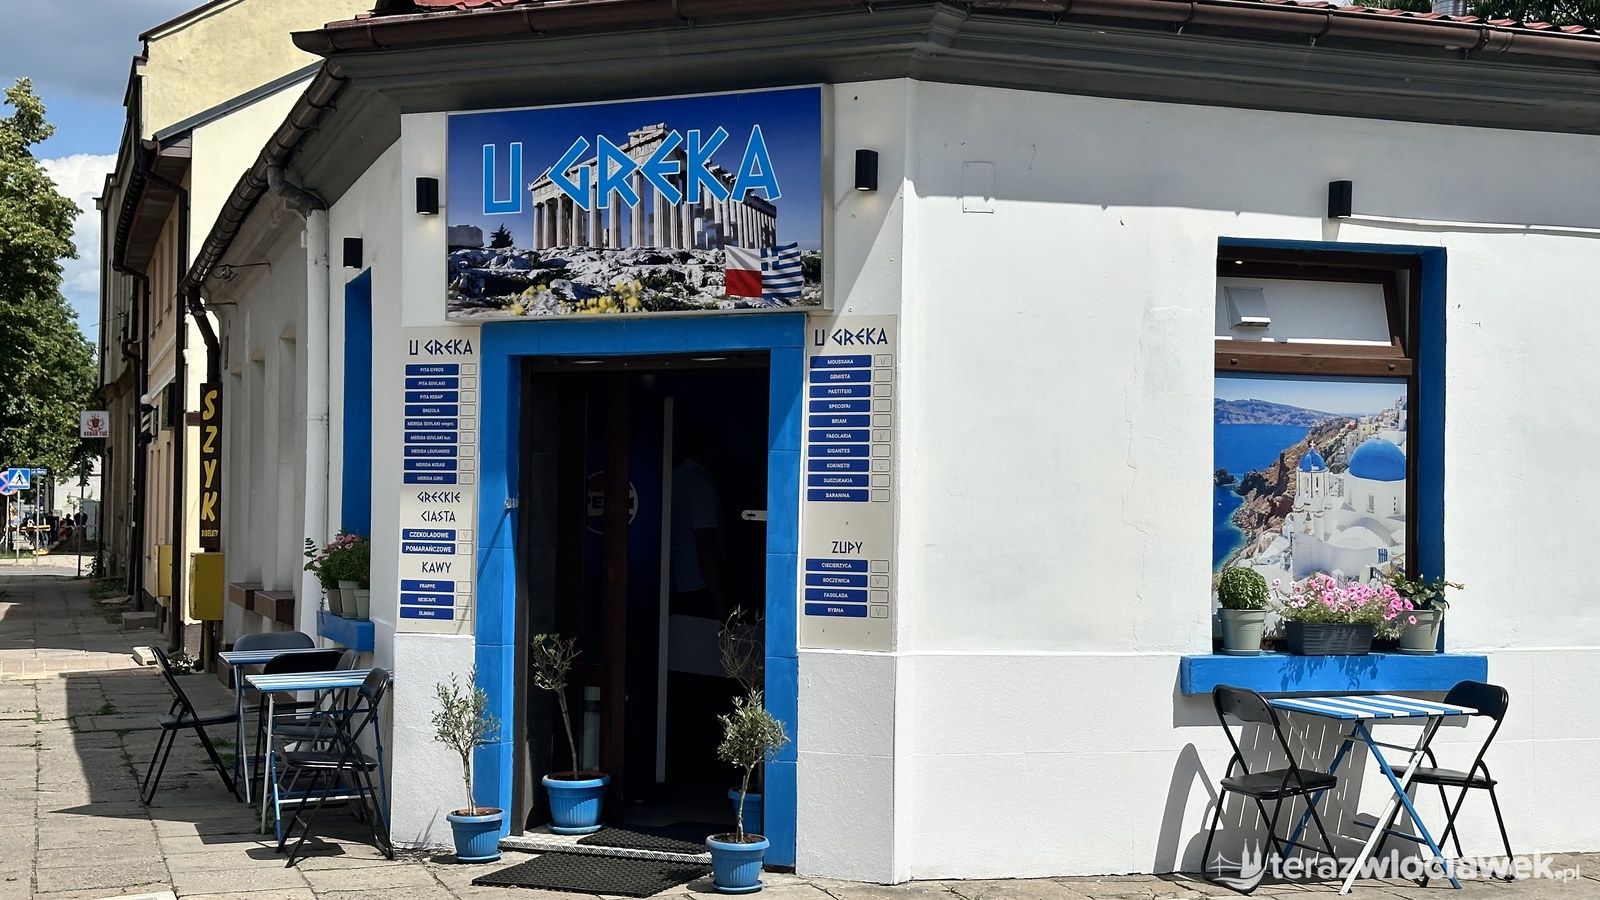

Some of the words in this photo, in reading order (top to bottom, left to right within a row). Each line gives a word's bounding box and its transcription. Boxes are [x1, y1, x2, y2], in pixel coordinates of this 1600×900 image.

[482, 142, 523, 215] U
[548, 124, 782, 211] GREKA
[815, 329, 825, 346] U
[831, 327, 888, 346] GREKA
[409, 340, 418, 356] U
[424, 339, 473, 355] GREKA
[202, 390, 218, 522] SZYK
[417, 491, 461, 503] GRECKIE
[420, 510, 456, 522] CIASTA
[409, 531, 449, 539] CZEKOLADOWE
[405, 544, 452, 553] POMARAŃCZOWE
[832, 540, 863, 554] ZUPY
[421, 561, 452, 573] KAWY
